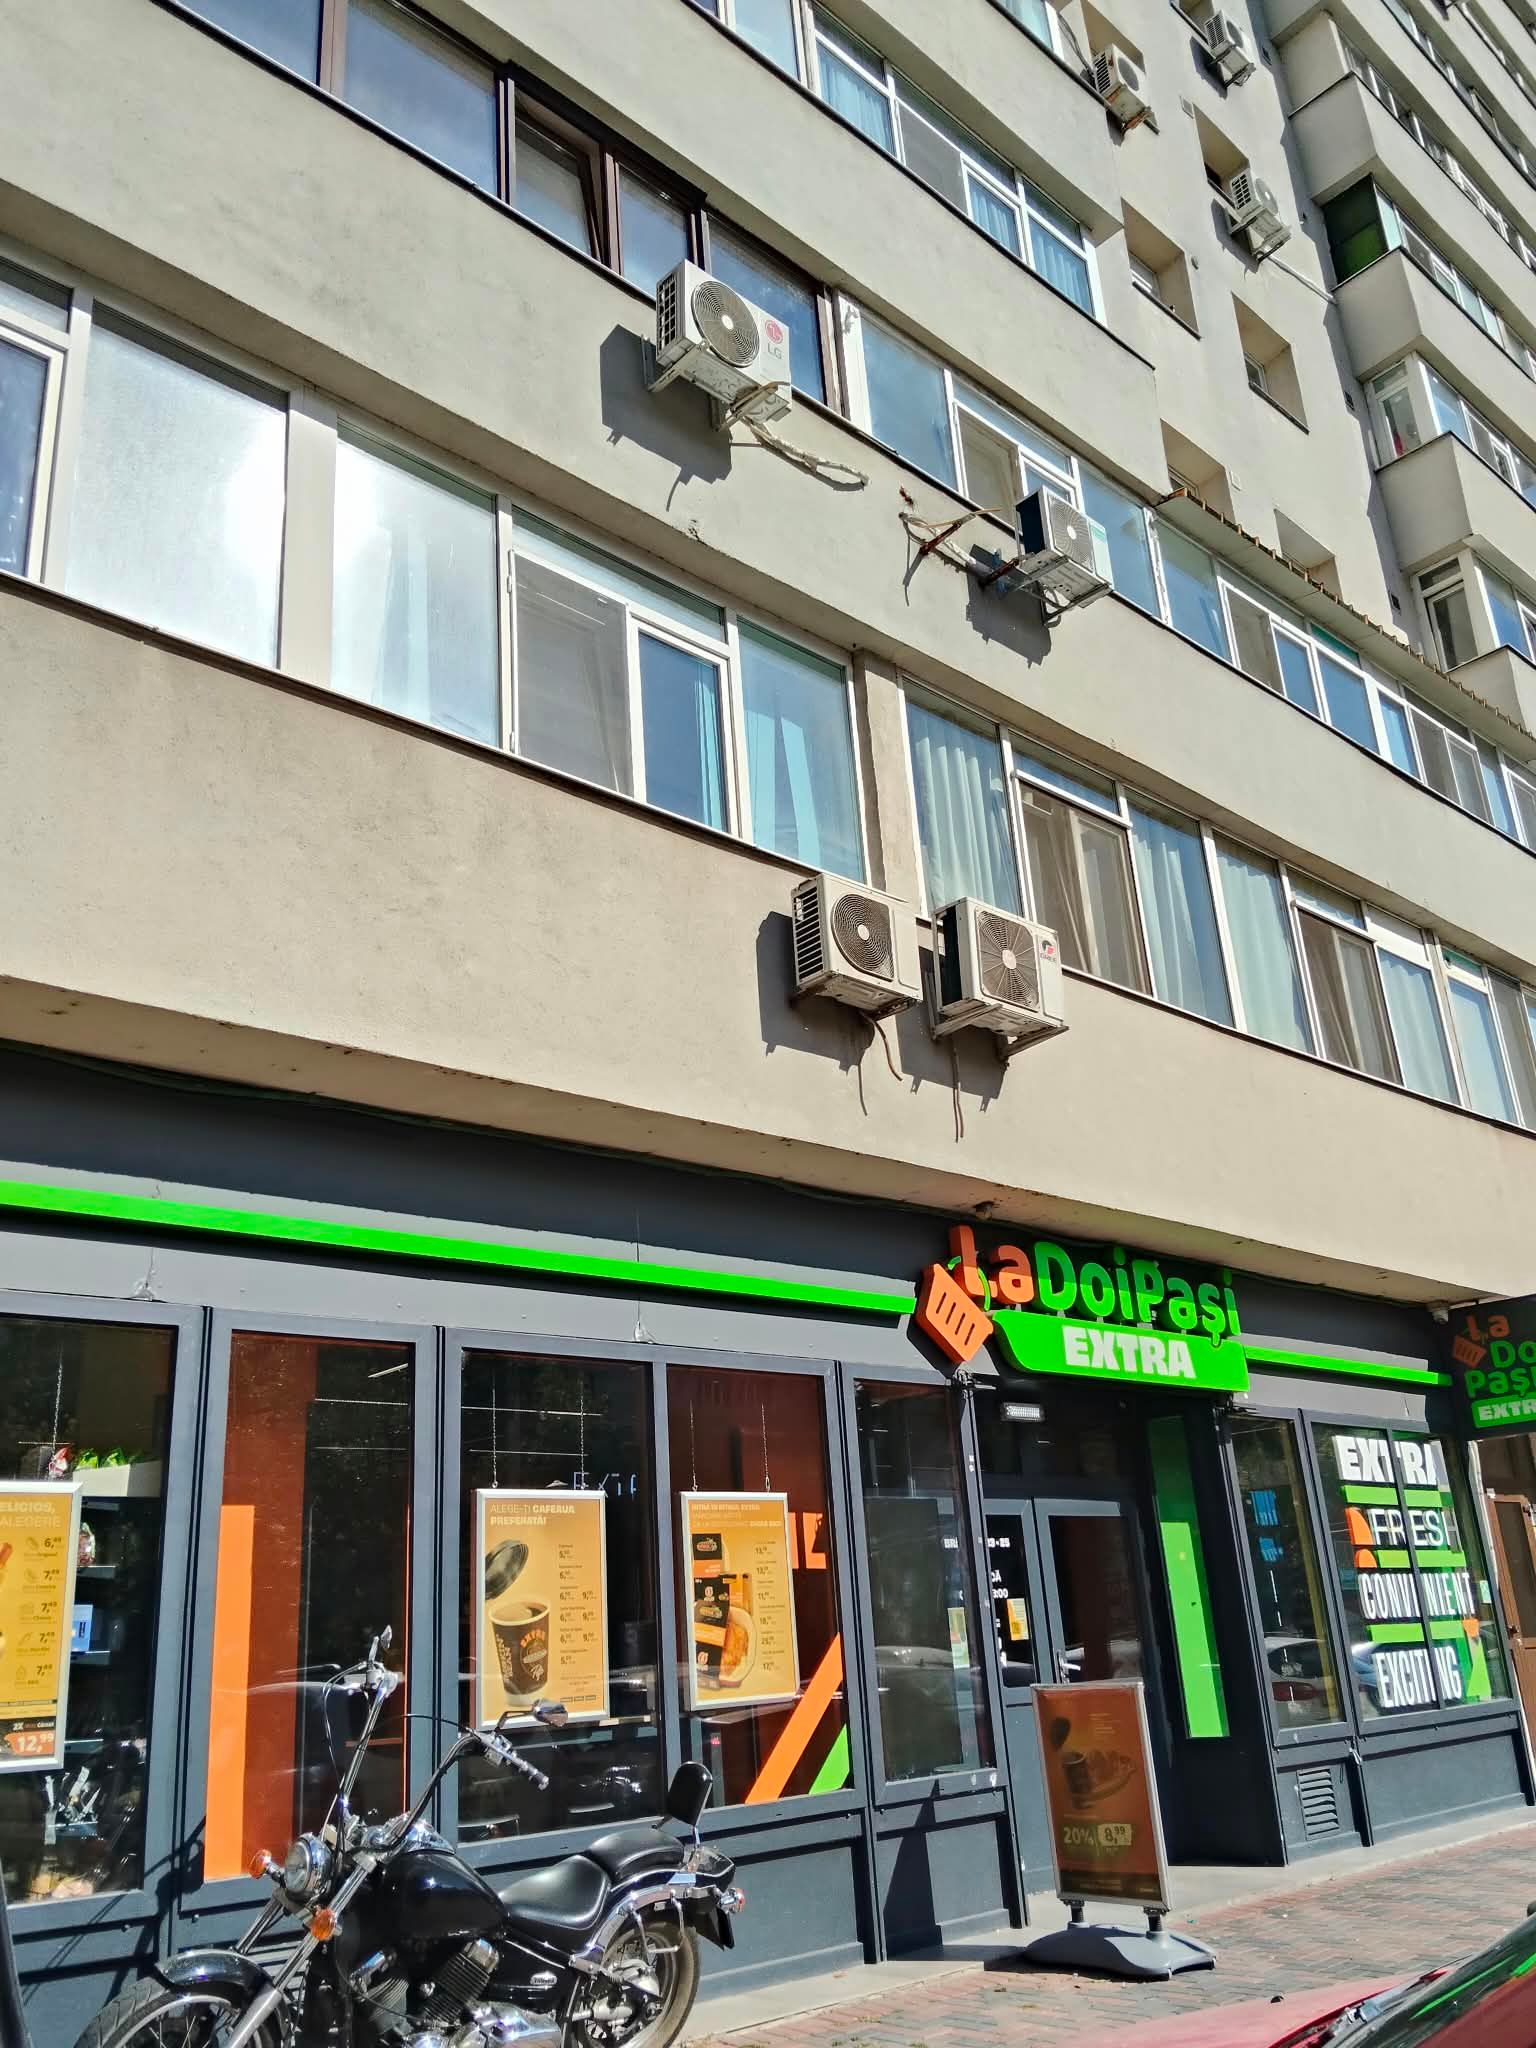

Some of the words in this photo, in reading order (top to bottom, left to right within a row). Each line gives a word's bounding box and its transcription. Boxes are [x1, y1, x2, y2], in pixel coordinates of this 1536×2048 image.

[767, 342, 783, 360] LG
[1062, 1325, 1197, 1380] EXTRA
[1366, 1508, 1462, 1549] FRESH
[1373, 1645, 1462, 1709] EXCITING
[17, 1732, 54, 1753] 12,99
[1063, 1826, 1096, 1847] 20%
[1104, 1825, 1127, 1845] 8,99
